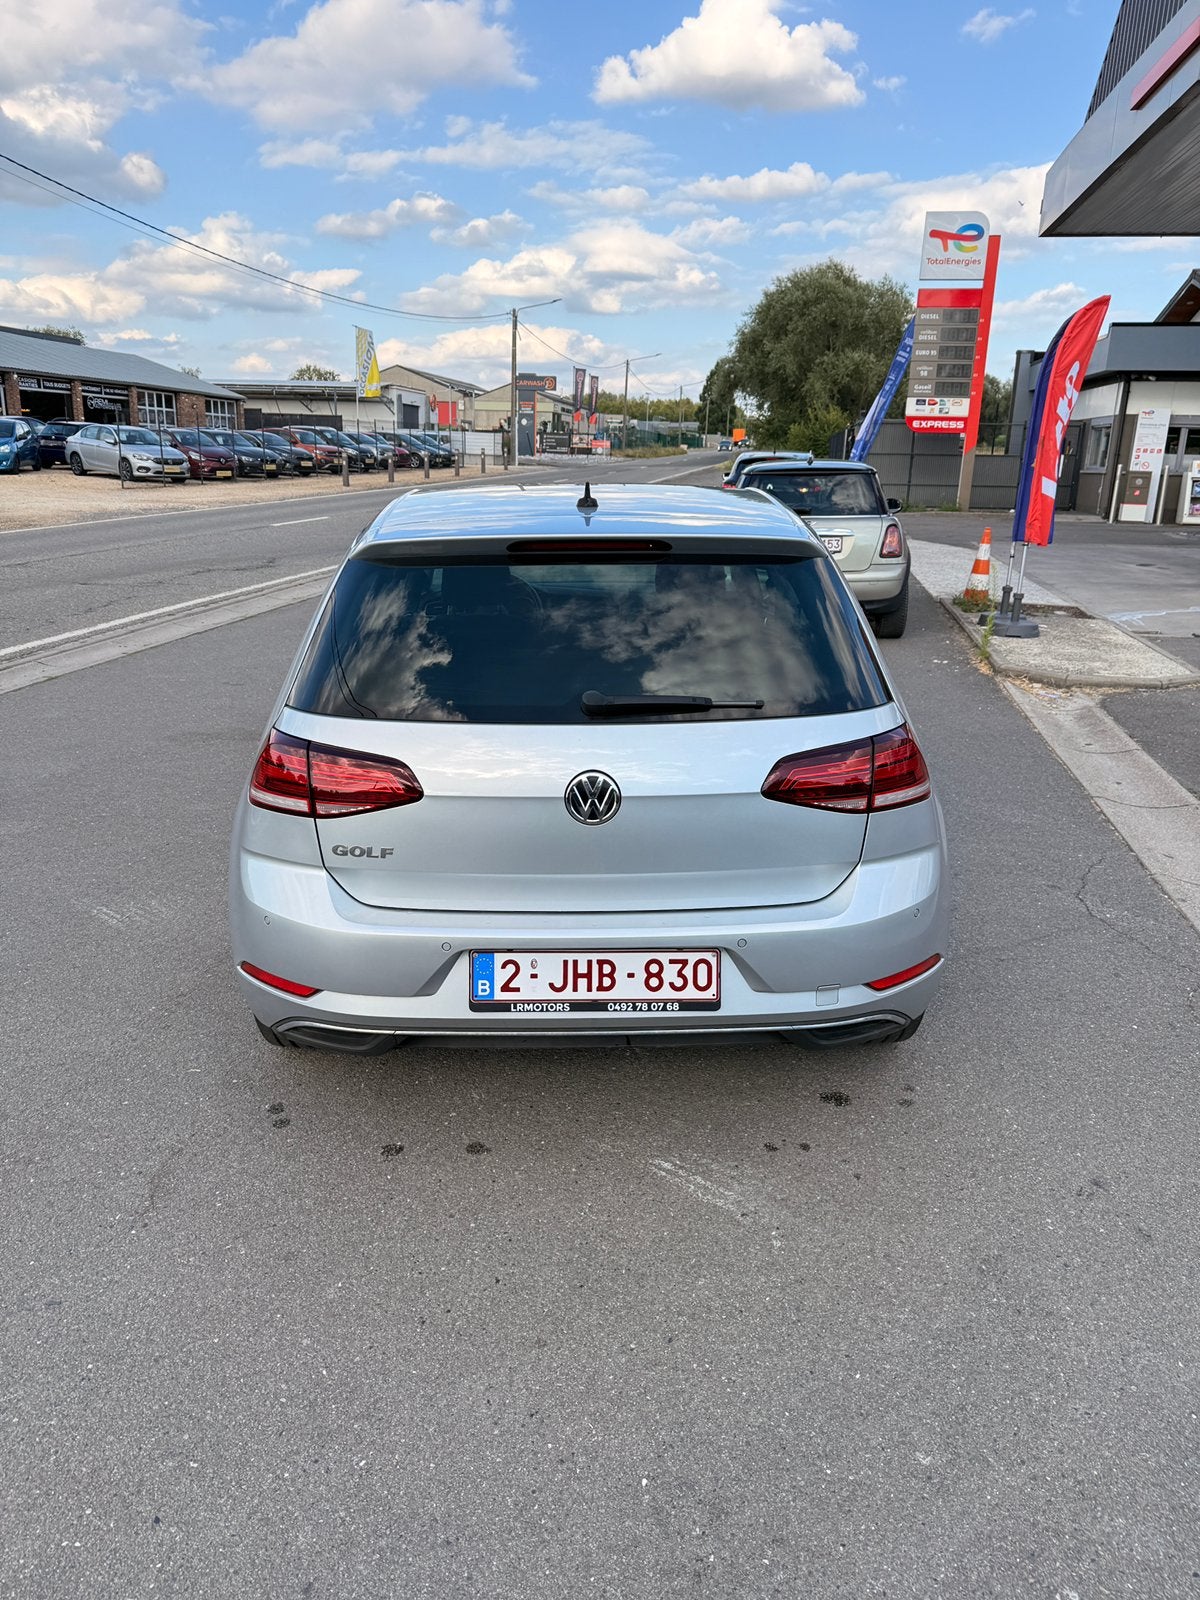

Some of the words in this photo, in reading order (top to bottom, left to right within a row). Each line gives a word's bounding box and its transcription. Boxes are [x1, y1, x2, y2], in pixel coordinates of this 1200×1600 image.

[926, 257, 982, 267] TotalEnergies
[912, 420, 965, 429] EXPRESS
[823, 539, 840, 549] 53
[331, 844, 395, 859] GOLF
[477, 980, 491, 996] B
[510, 1003, 571, 1012] LRMOTORS
[607, 1002, 633, 1011] 0492
[635, 1003, 649, 1011] 78
[650, 1003, 664, 1011] 07
[666, 1002, 680, 1011] 68
